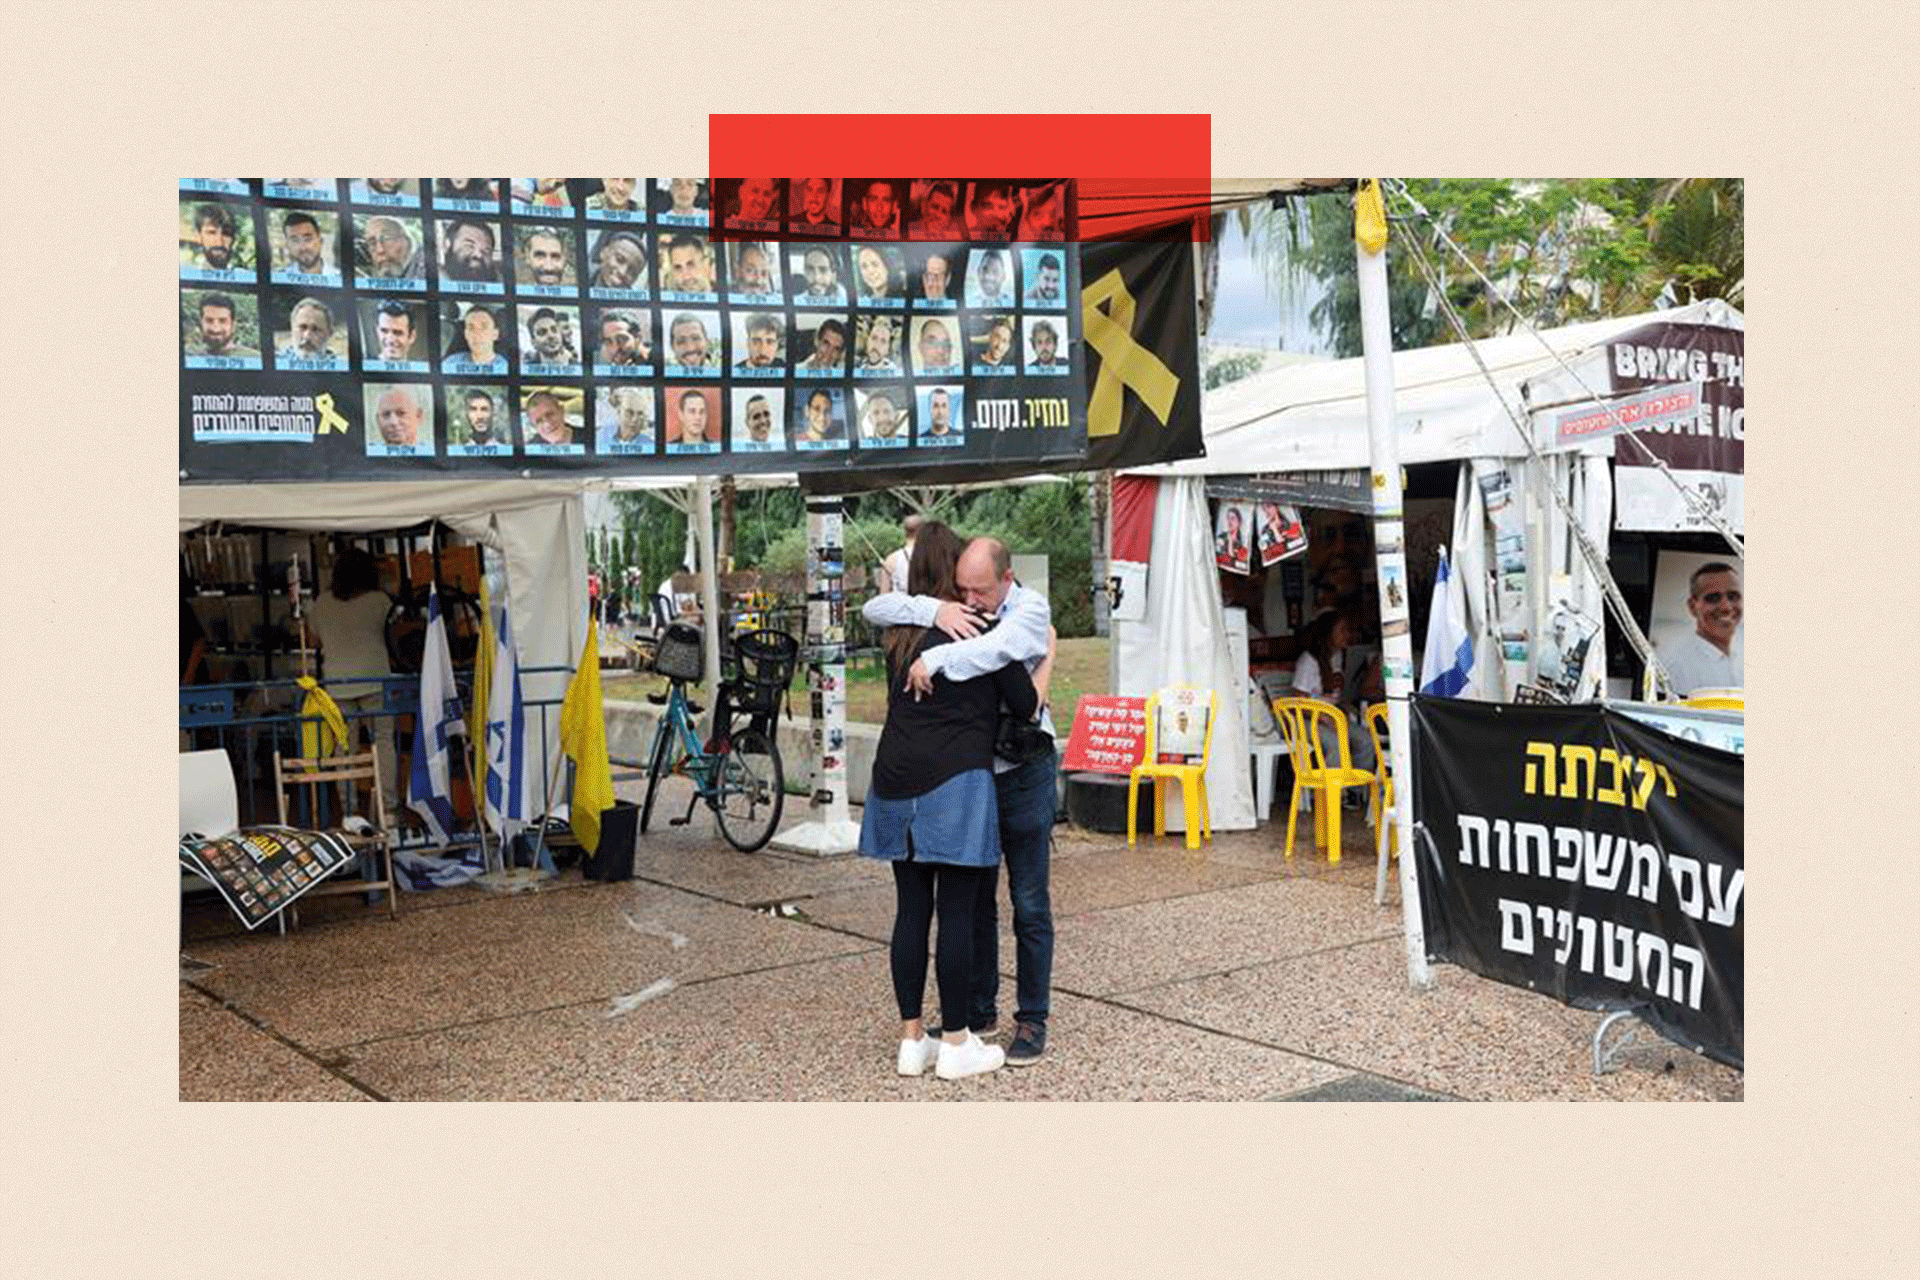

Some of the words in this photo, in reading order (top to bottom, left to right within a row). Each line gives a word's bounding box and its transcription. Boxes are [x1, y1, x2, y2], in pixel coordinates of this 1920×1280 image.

[1614, 343, 1708, 382] BRING
[236, 395, 289, 412] המשפחות
[193, 414, 256, 434] והנעדרים
[258, 414, 315, 434] החטופים
[1456, 814, 1662, 903] משפחות
[1667, 853, 1744, 928] עם
[1498, 898, 1706, 1011] החטופים
